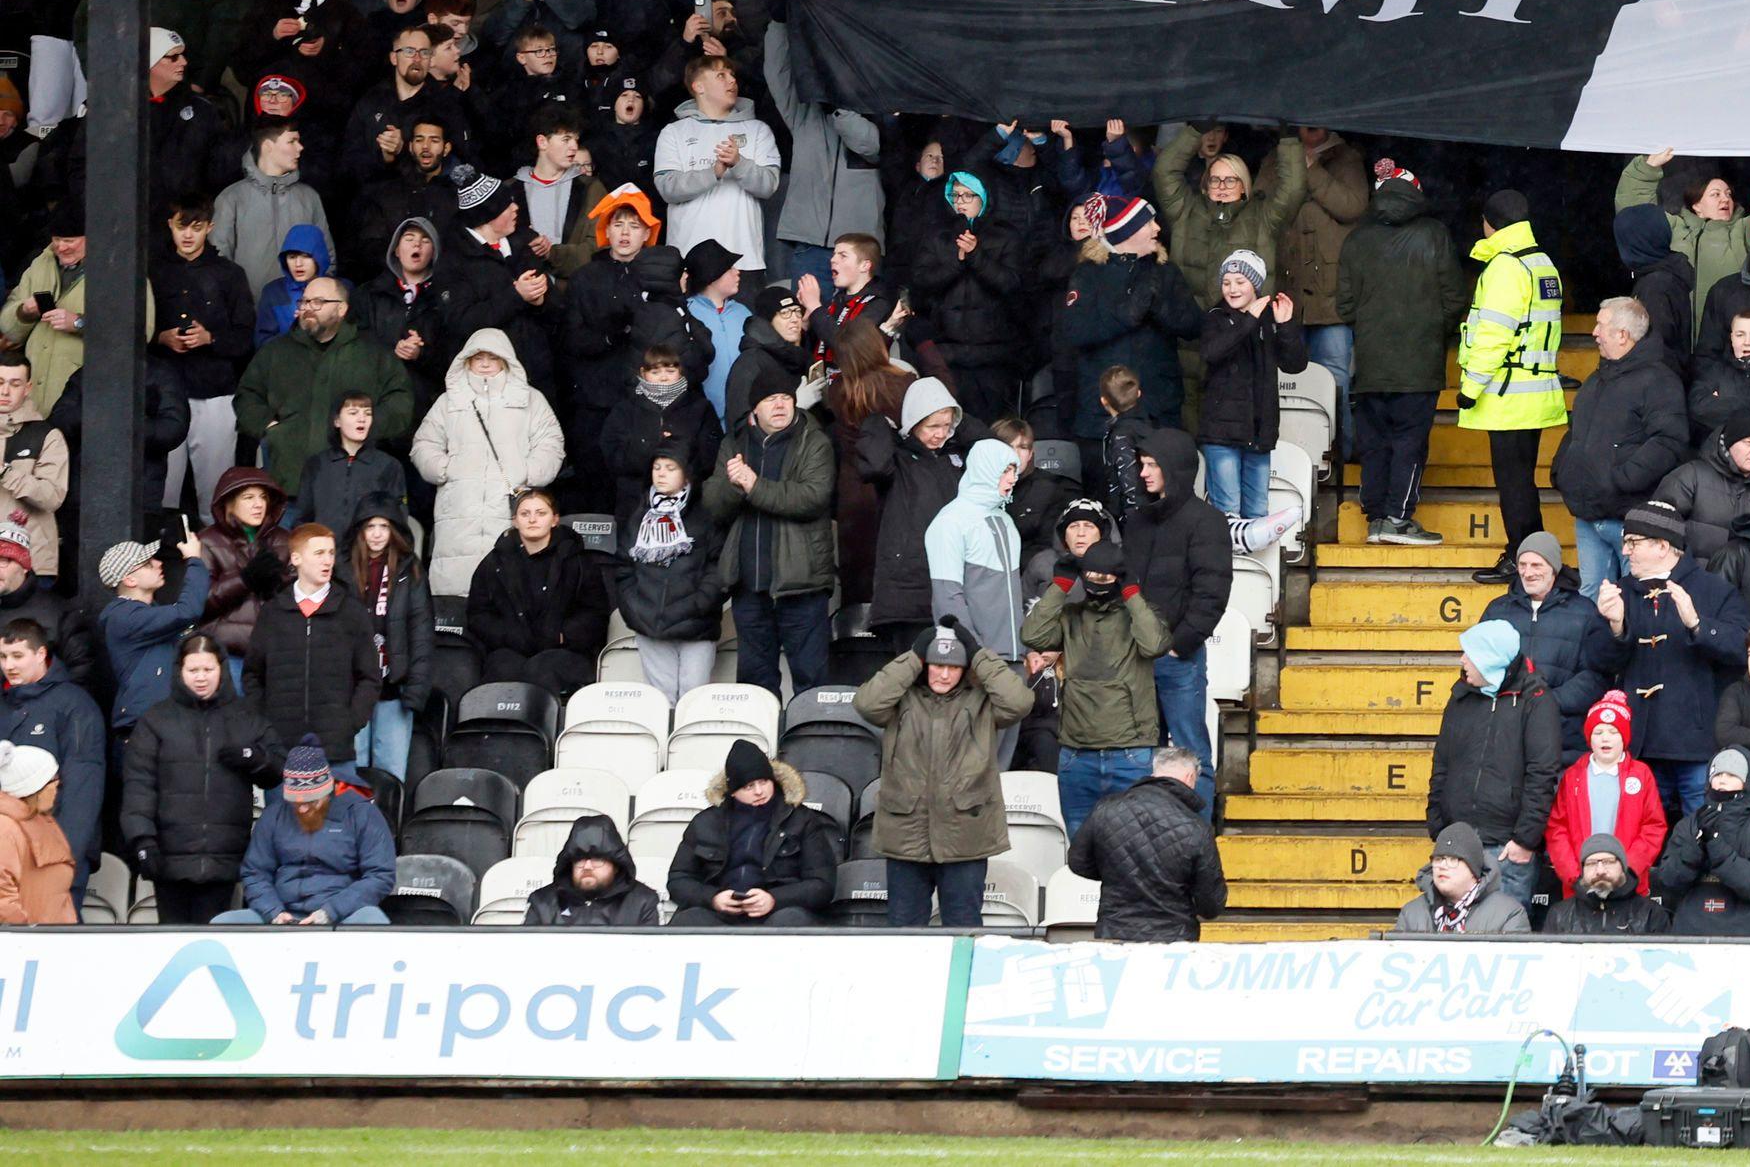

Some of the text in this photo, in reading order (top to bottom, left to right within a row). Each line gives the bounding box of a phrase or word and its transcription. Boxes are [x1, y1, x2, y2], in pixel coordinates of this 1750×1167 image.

[1469, 513, 1489, 538] H
[1439, 596, 1462, 623] G
[605, 690, 642, 698] RESERVED
[1416, 680, 1435, 705] F
[1387, 764, 1406, 789] E
[1351, 848, 1367, 875] D
[1161, 951, 1543, 993] TOMMY SANT
[1354, 983, 1534, 1030] Car Care
[1043, 1044, 1222, 1074] SERVICE
[1295, 1046, 1472, 1075] REPAIRS
